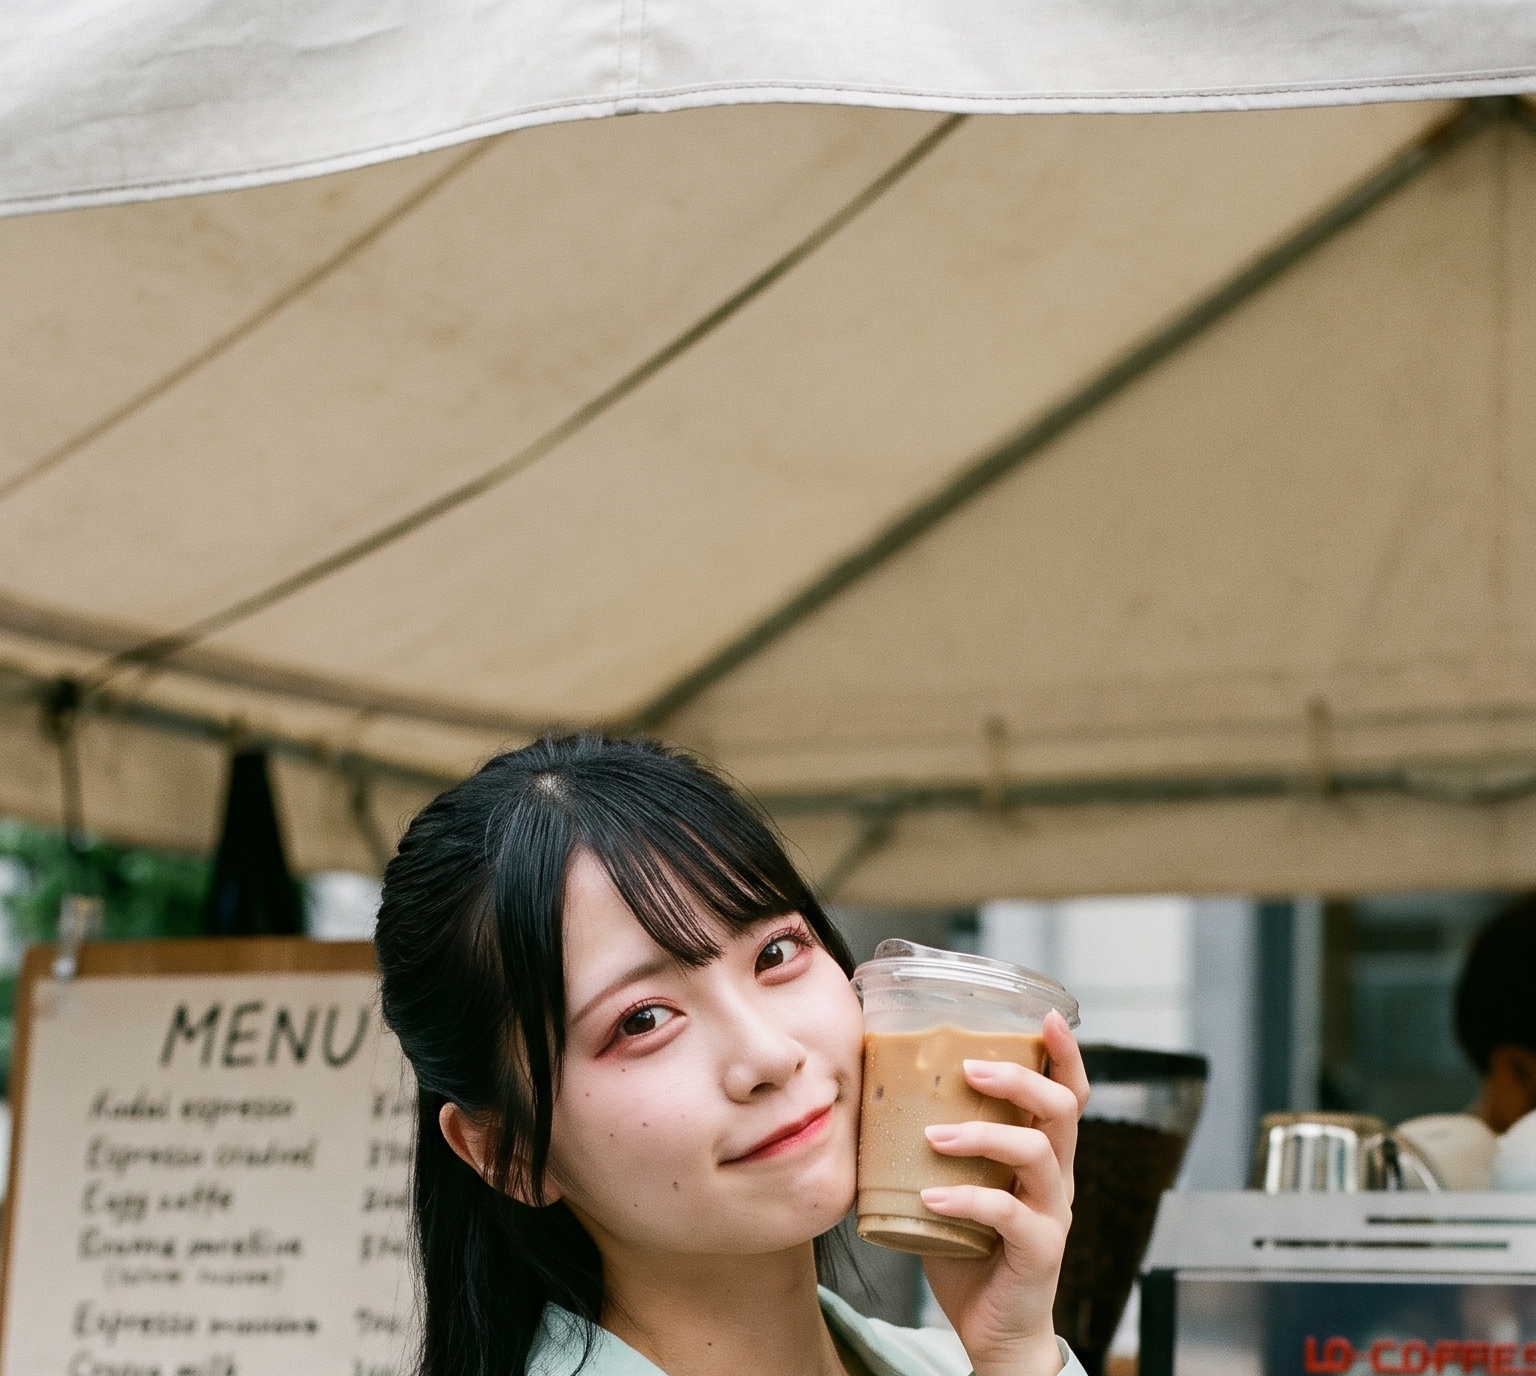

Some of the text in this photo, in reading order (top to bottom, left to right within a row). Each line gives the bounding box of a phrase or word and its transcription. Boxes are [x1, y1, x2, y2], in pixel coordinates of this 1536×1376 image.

[160, 999, 372, 1068] MENU
[180, 1098, 294, 1129] espresso
[86, 1136, 203, 1175] Espresso
[72, 1301, 197, 1344] Espresso
